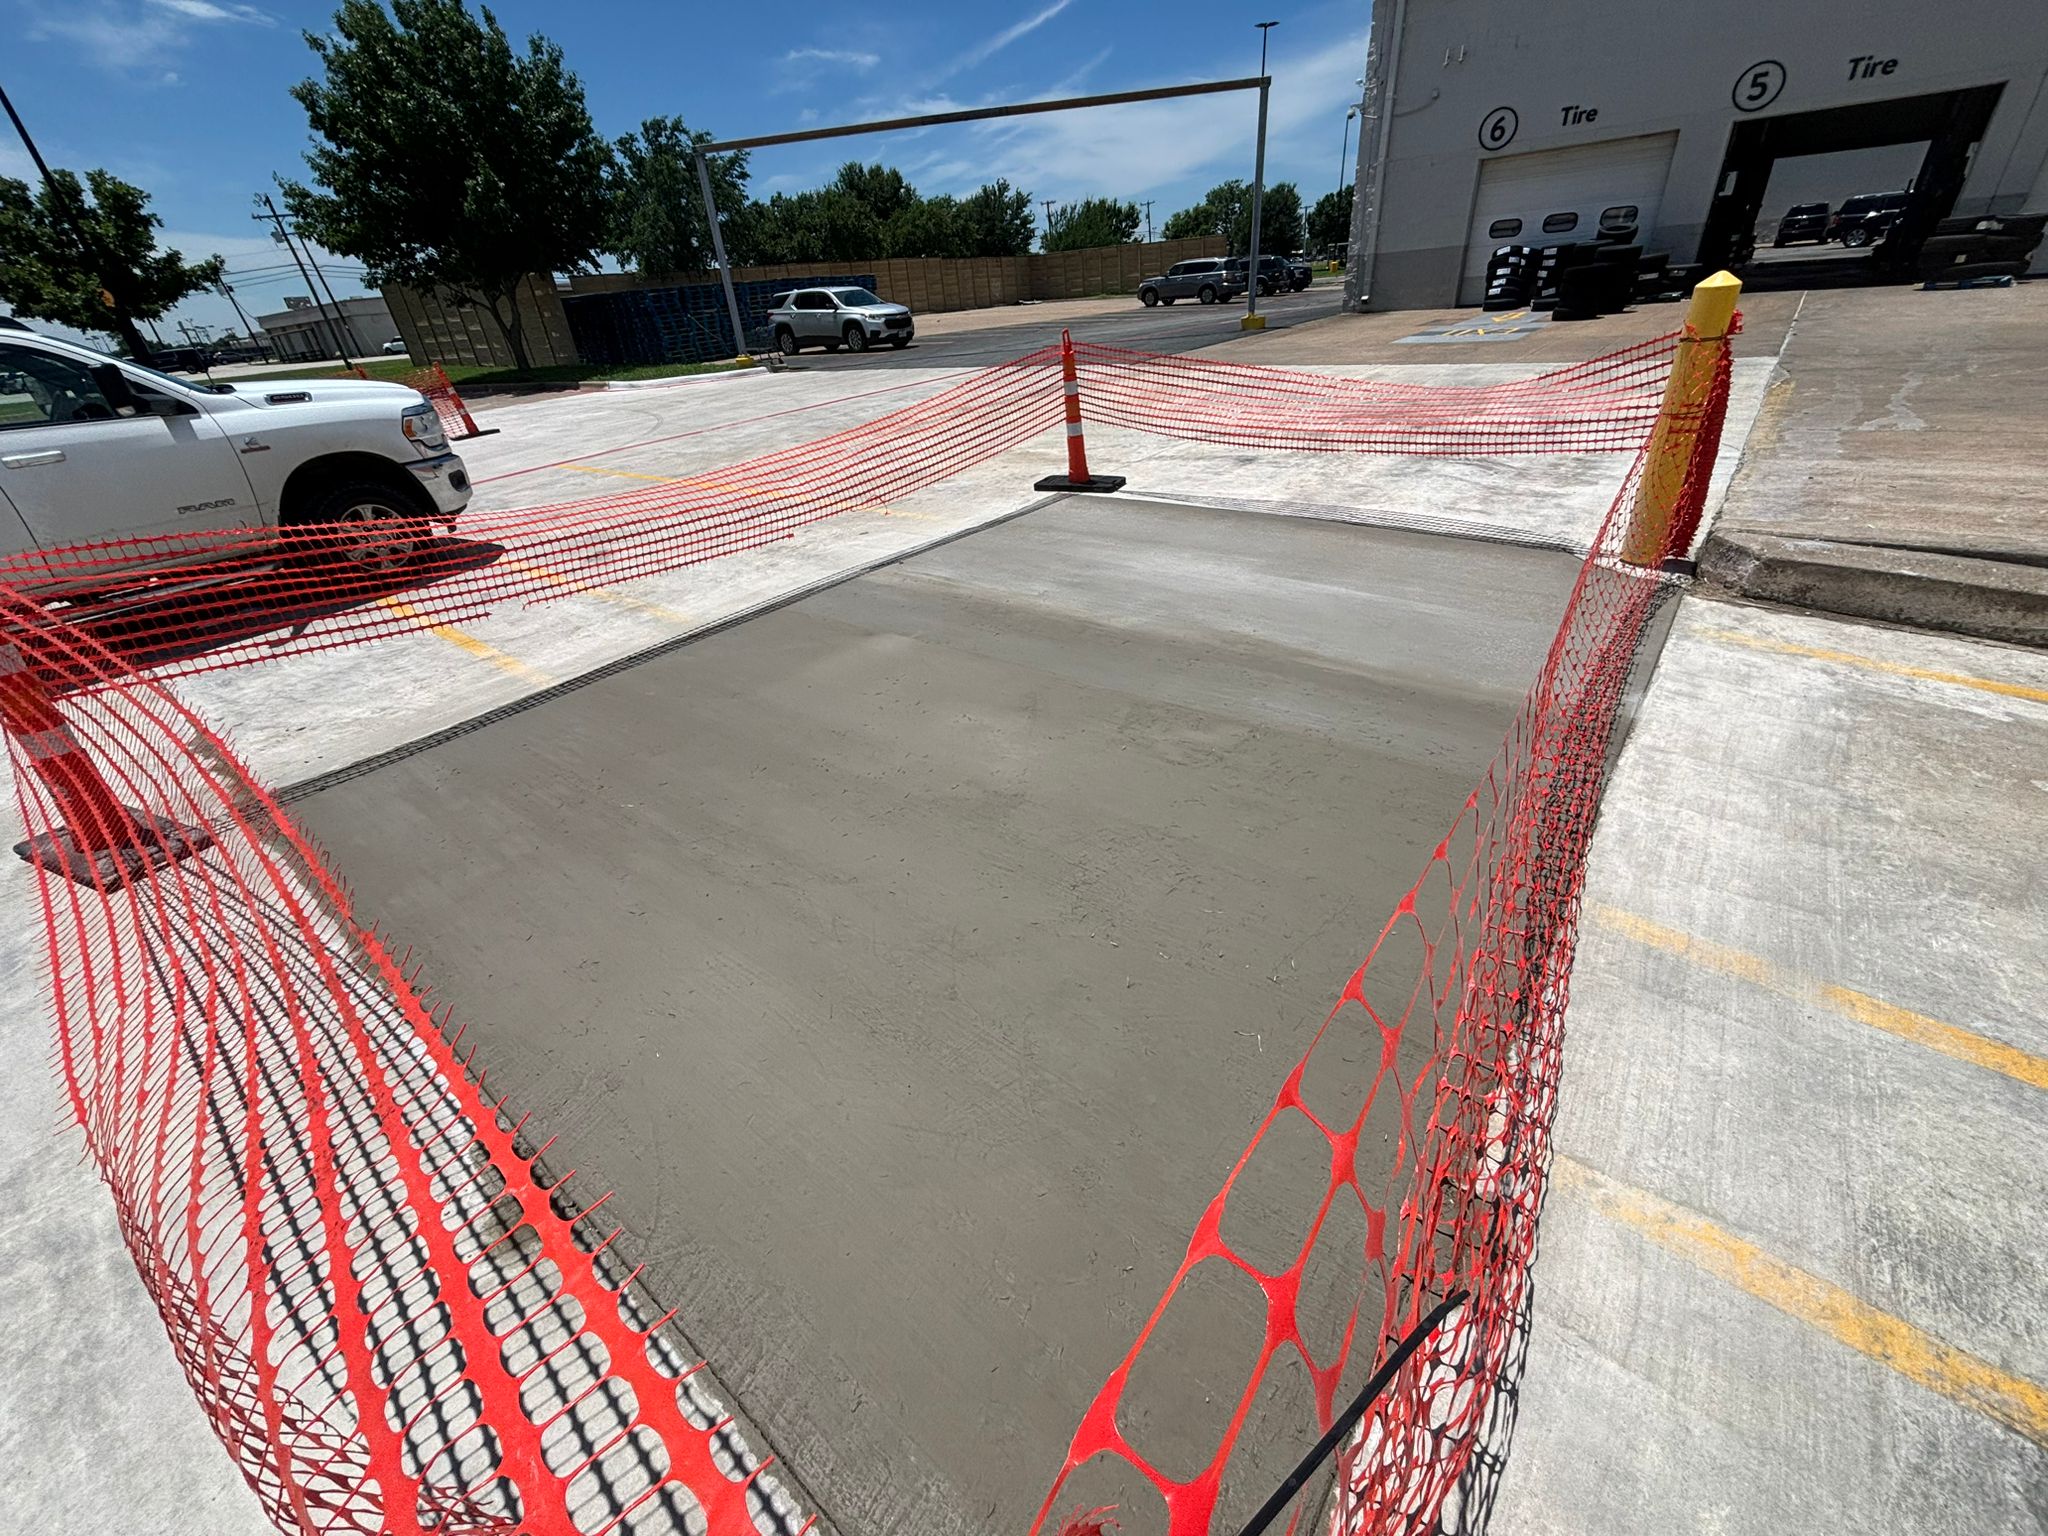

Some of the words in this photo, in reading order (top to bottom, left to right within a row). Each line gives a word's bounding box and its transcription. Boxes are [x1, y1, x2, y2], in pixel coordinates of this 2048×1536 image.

[1746, 71, 1769, 102] 5
[1848, 55, 1898, 81] Tire
[1490, 116, 1506, 142] 6
[1561, 105, 1598, 127] Tire
[177, 498, 236, 514] RAM
